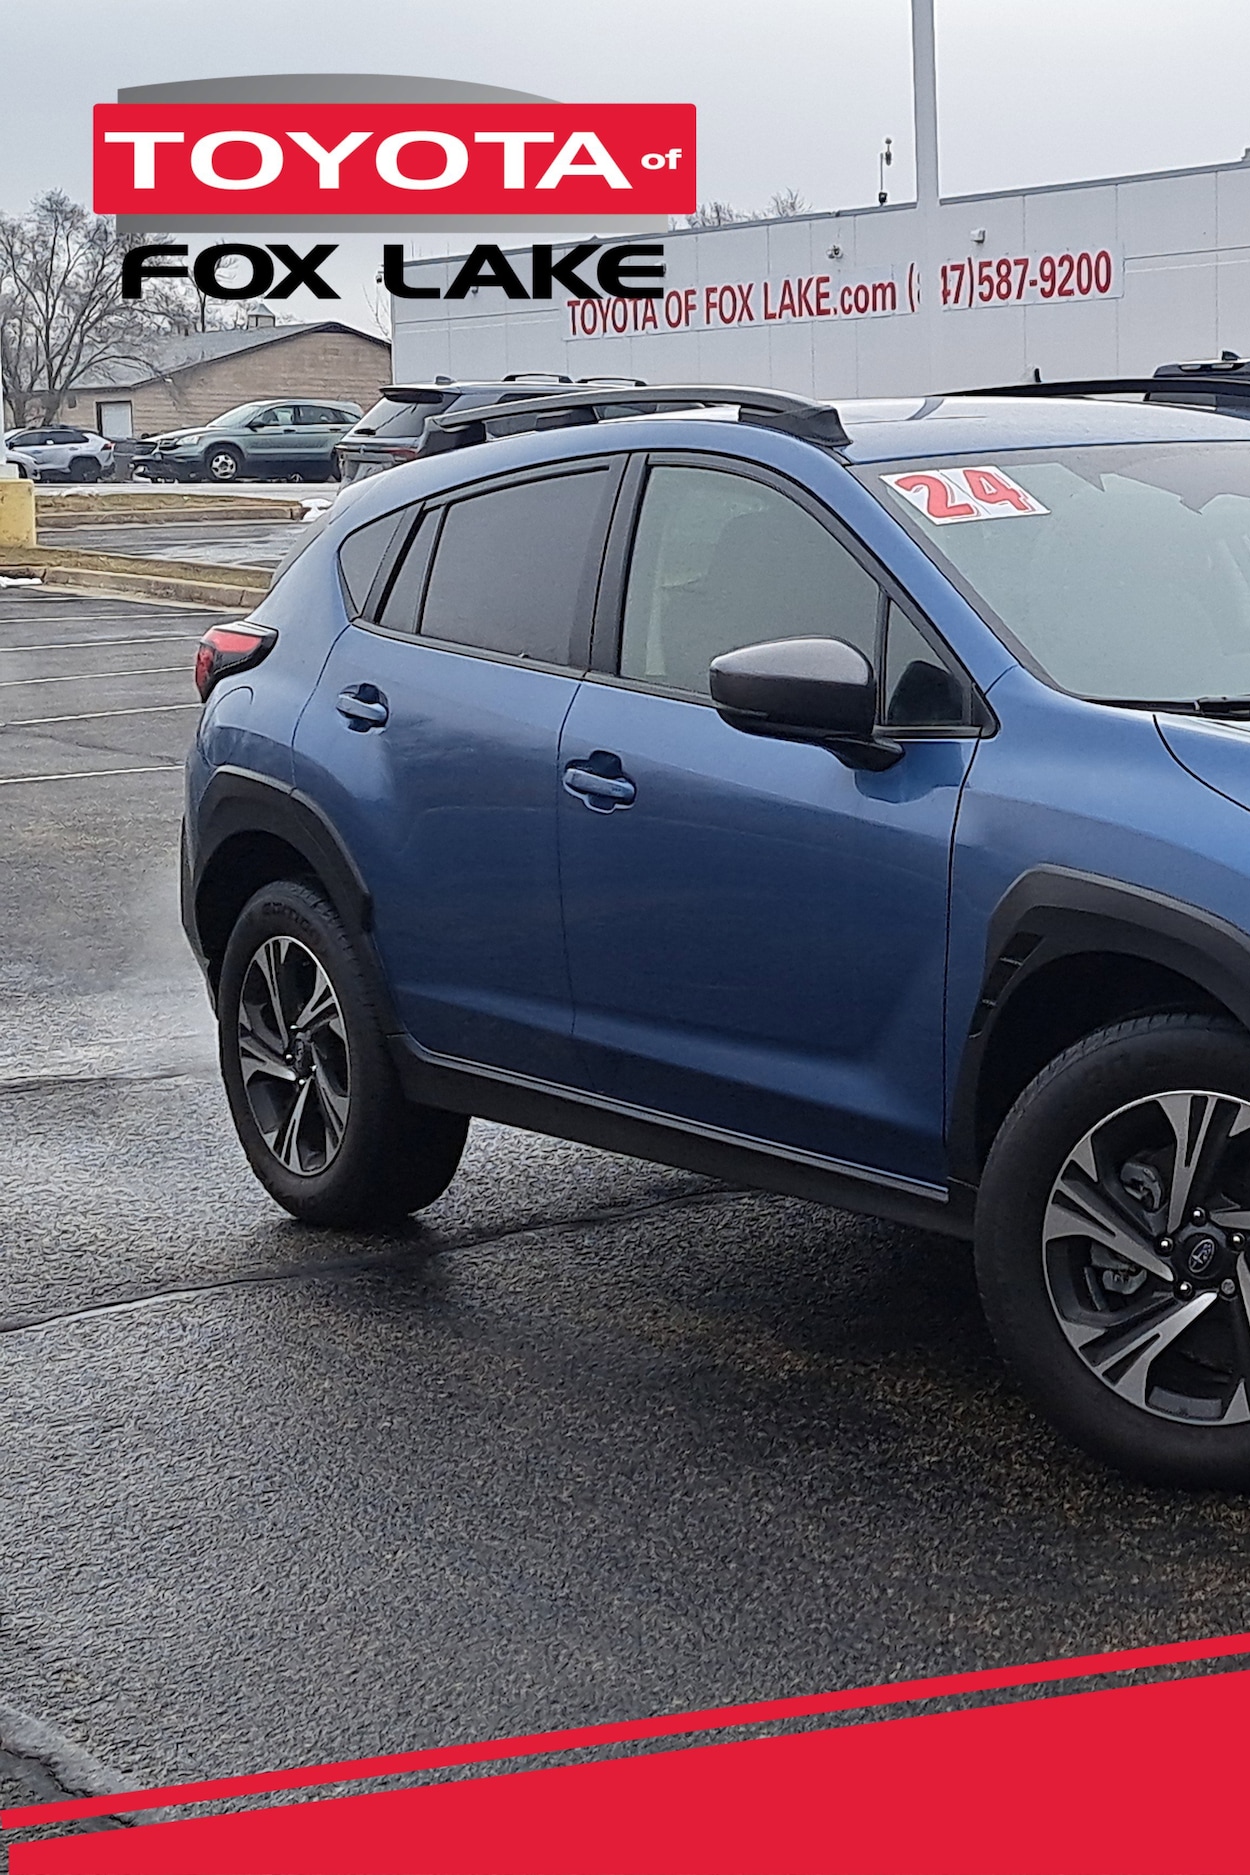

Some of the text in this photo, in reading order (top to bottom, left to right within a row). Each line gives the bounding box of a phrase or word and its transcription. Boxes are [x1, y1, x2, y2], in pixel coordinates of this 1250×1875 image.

[567, 297, 659, 336] TOYOTA
[665, 289, 697, 329] OF
[705, 283, 755, 325] FOX
[763, 276, 897, 320] LAKE.com
[895, 469, 1032, 519] 24
